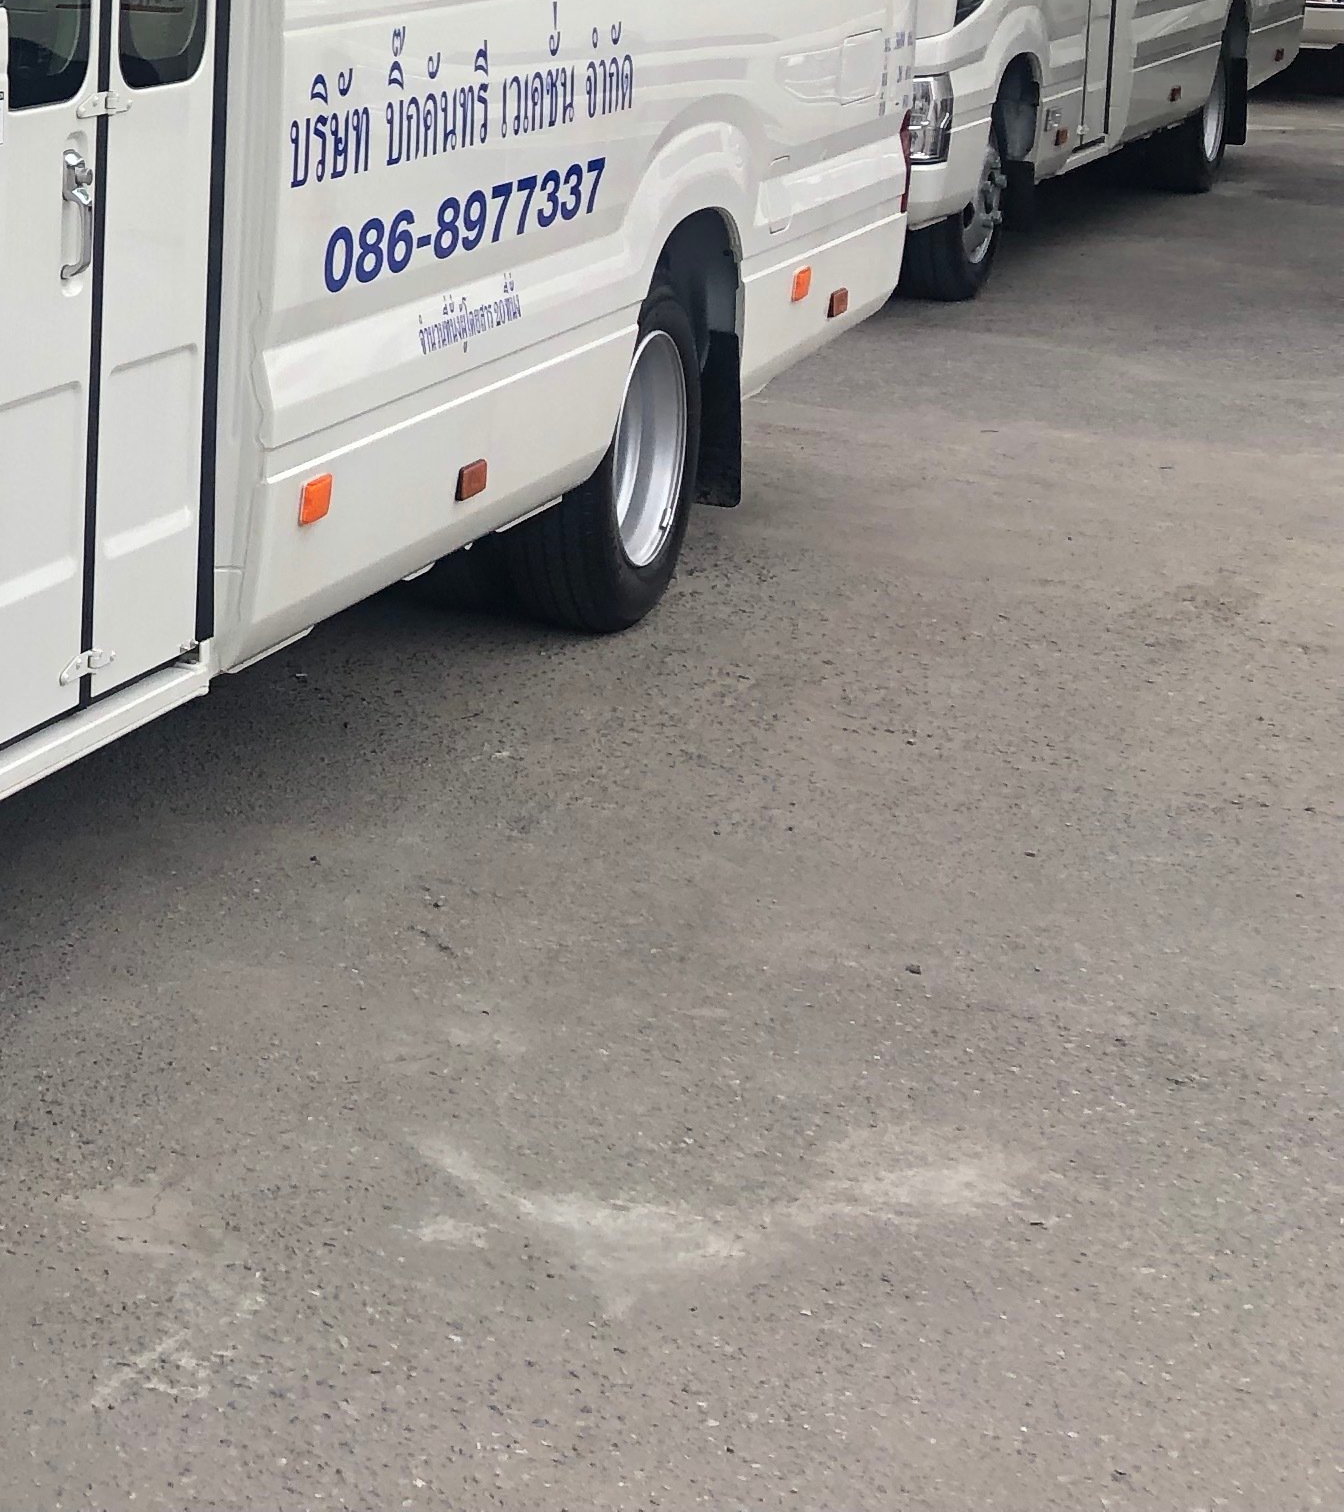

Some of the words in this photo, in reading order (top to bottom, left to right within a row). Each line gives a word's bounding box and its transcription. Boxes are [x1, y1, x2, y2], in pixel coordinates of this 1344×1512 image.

[289, 66, 371, 189] บริษัท
[585, 20, 635, 120] จำกัด
[323, 156, 607, 294] 086-8977337
